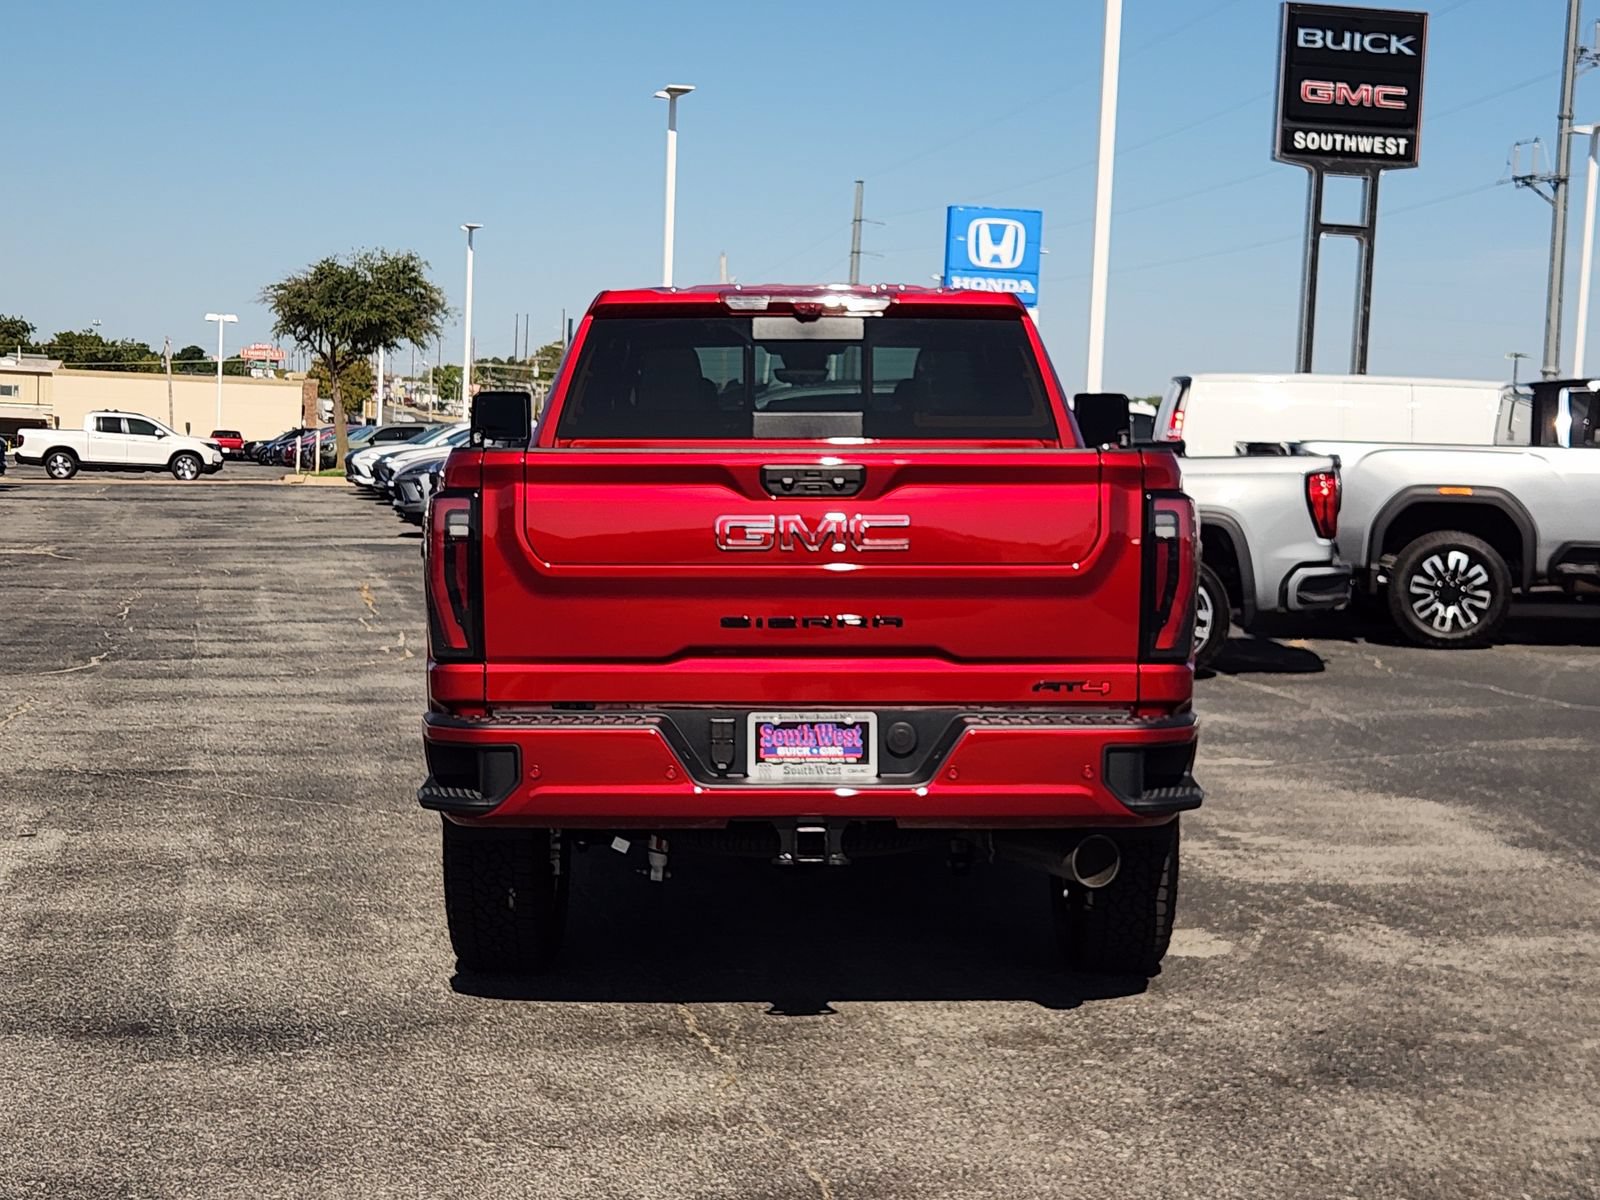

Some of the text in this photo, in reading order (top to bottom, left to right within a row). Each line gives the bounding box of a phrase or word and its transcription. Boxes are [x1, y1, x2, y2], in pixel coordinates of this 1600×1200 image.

[1297, 27, 1416, 56] BUICK
[1301, 79, 1408, 109] GMC
[1294, 131, 1408, 155] SOUTHWEST
[951, 276, 1036, 294] HONDA
[715, 513, 910, 552] GMC
[720, 614, 903, 629] SIERRA
[1032, 681, 1110, 695] AT4
